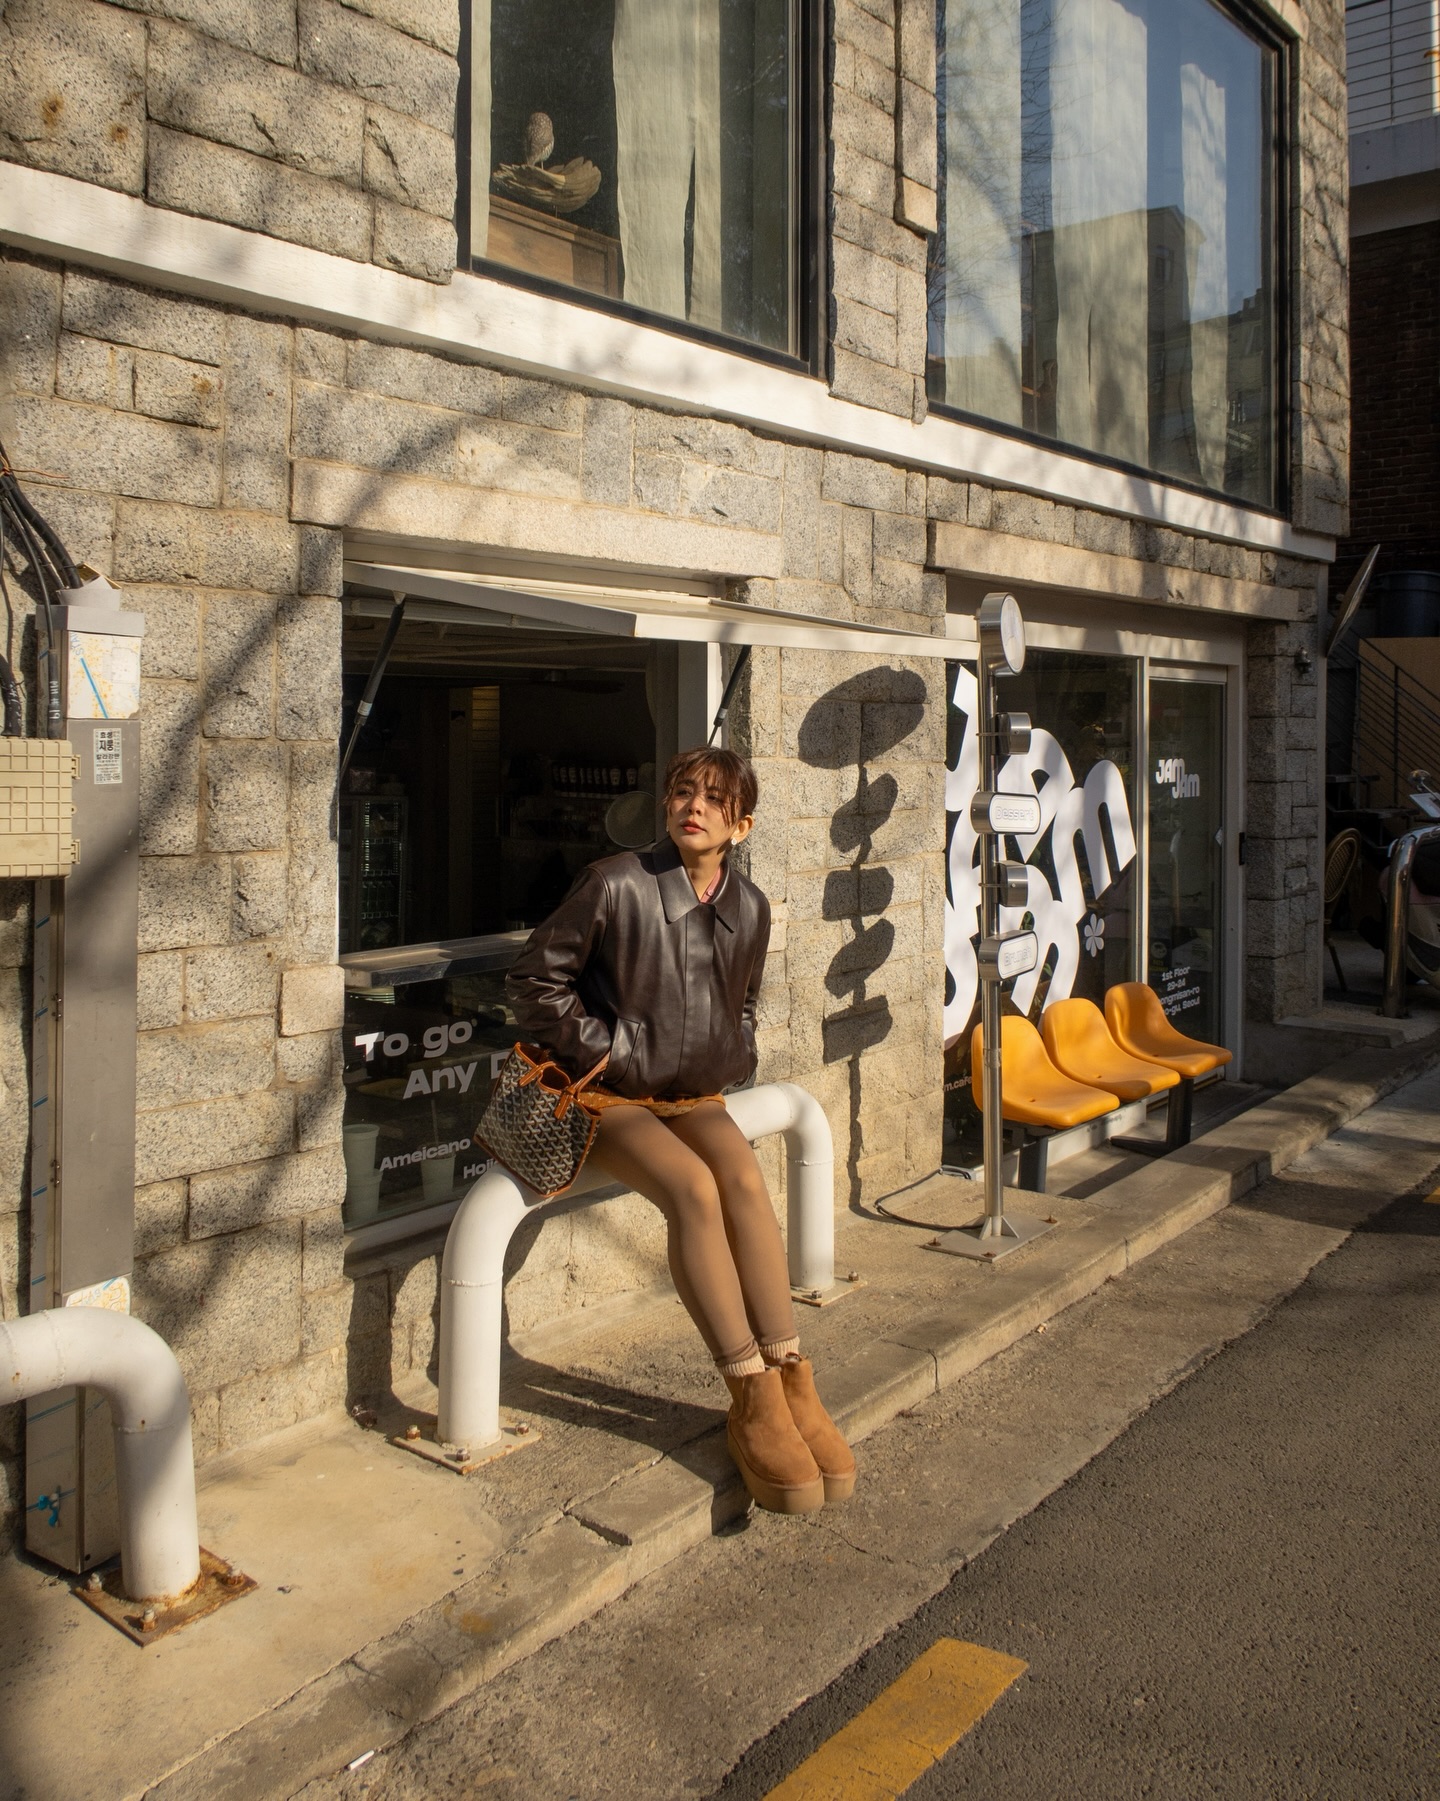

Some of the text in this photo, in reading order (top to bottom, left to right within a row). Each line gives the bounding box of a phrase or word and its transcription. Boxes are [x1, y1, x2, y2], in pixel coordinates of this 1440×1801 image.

[995, 805, 1035, 821] Dessert
[1004, 946, 1032, 967] Brunch
[1161, 966, 1191, 981] 1st Floor
[1160, 986, 1200, 1005] ongmisan-ro
[1165, 996, 1200, 1016] o-gu, Seoul
[355, 1021, 473, 1062] To go
[403, 1062, 478, 1100] Any
[379, 1137, 471, 1172] Ameicano
